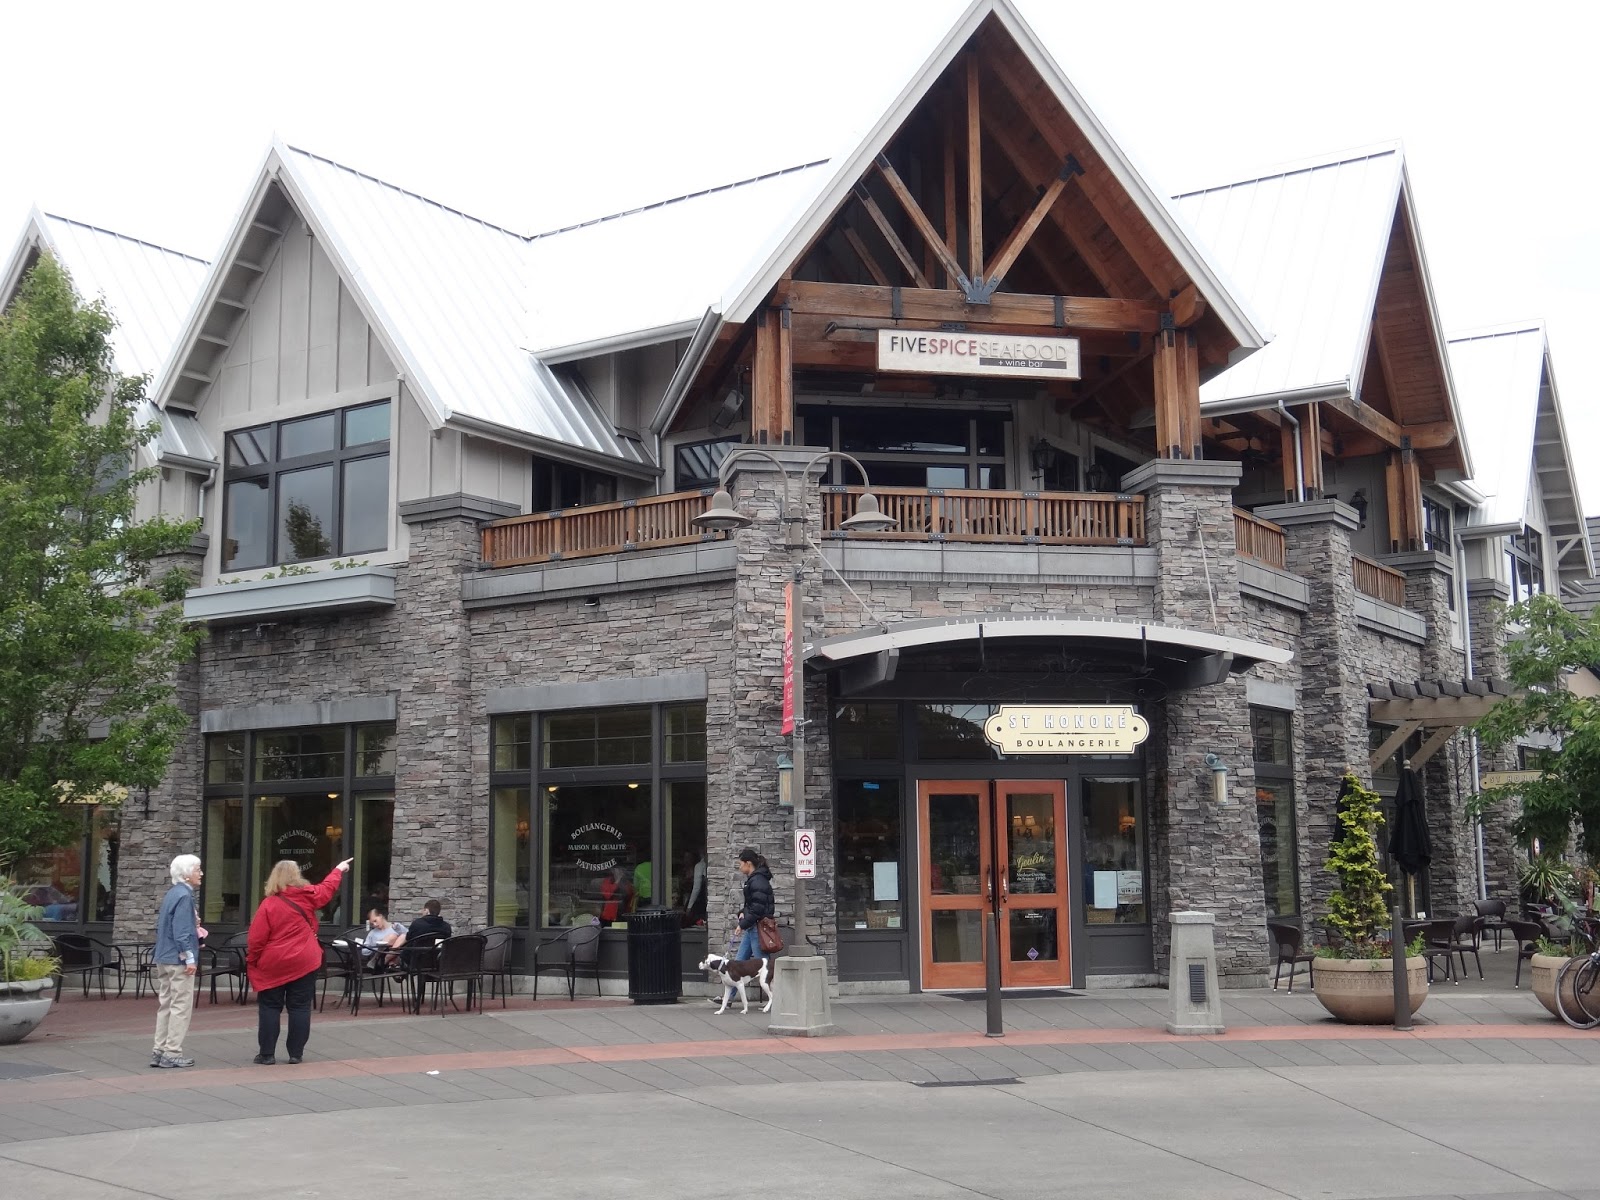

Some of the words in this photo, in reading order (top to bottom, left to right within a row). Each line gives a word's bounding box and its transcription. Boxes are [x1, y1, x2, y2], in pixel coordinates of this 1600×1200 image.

[891, 336, 927, 353] FIVE
[928, 338, 978, 356] SPICE
[1005, 359, 1026, 367] wine
[1028, 360, 1043, 368] bar
[1009, 715, 1030, 728] ST
[571, 823, 622, 840] BOULANGERIE
[576, 858, 617, 871] PATISSERIE
